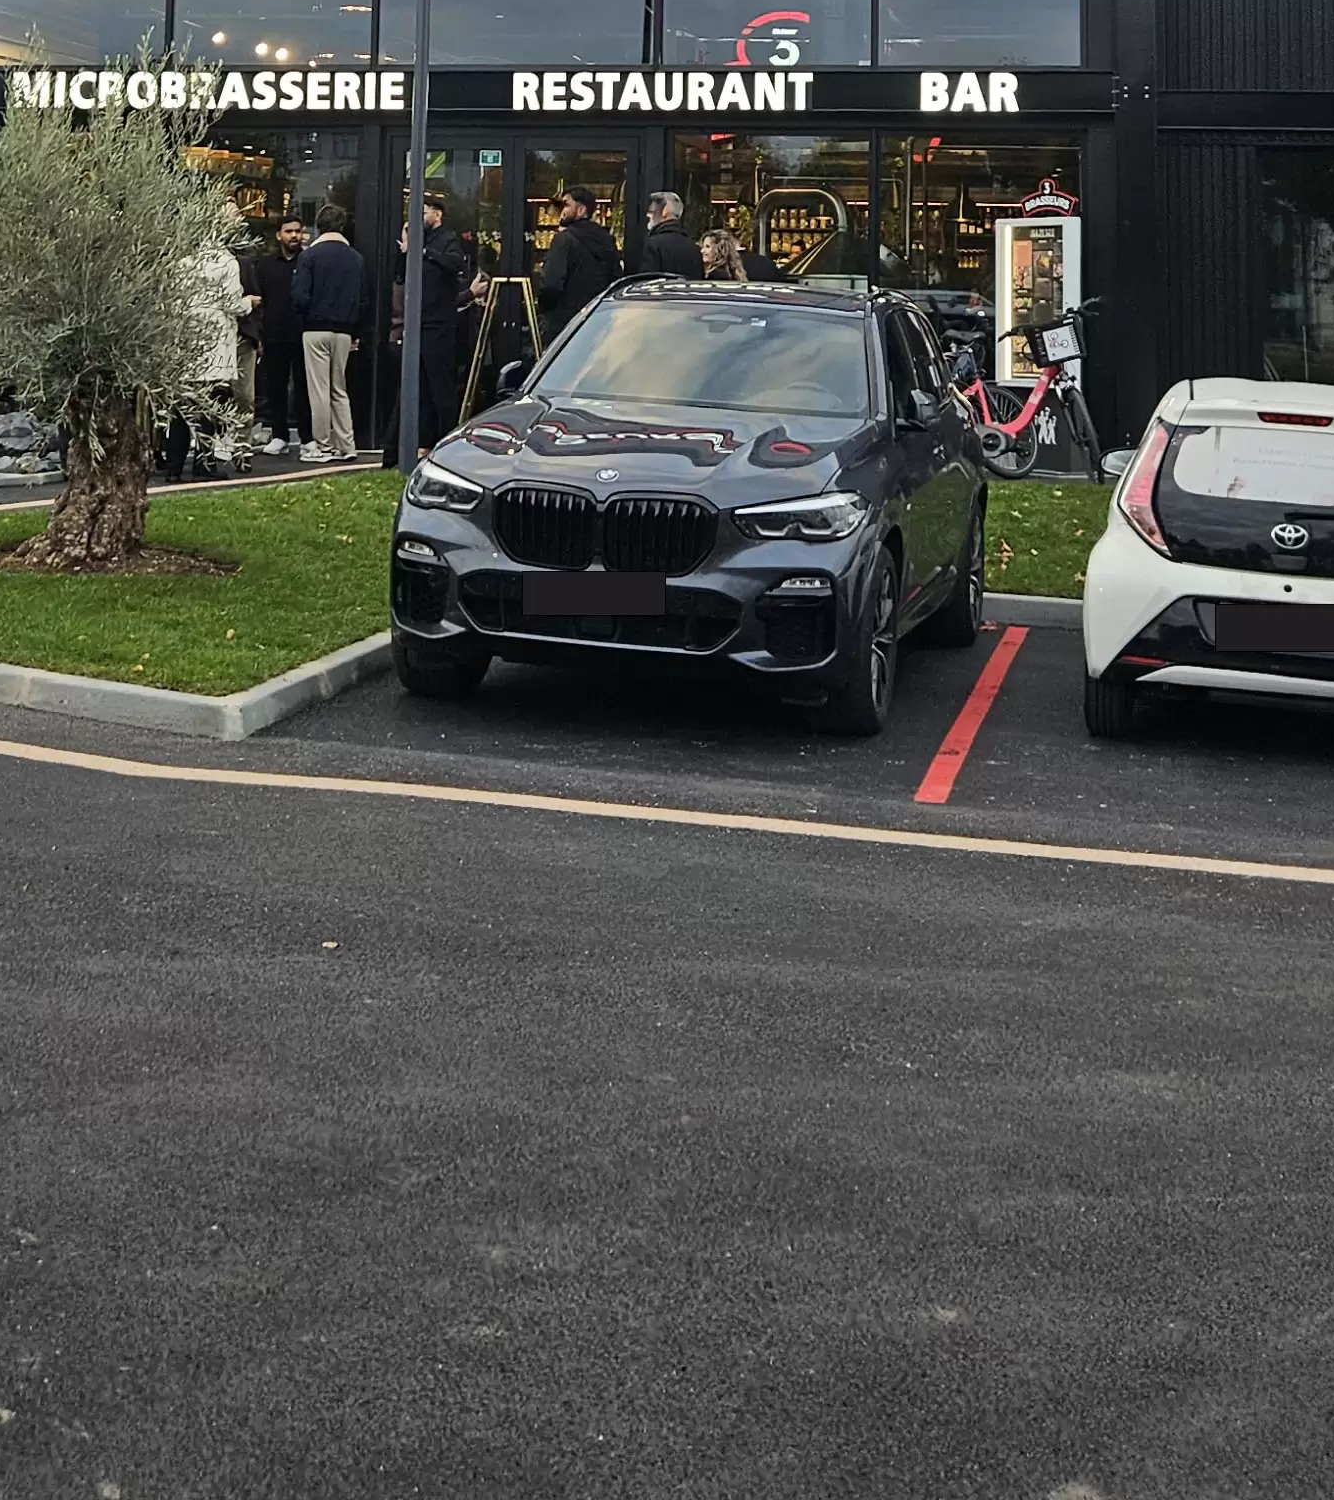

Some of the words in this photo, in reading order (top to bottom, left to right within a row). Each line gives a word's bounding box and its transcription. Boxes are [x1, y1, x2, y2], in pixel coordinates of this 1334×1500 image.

[512, 71, 815, 111] RESTAURANT
[919, 71, 1020, 113] BAR
[1042, 182, 1052, 195] 3
